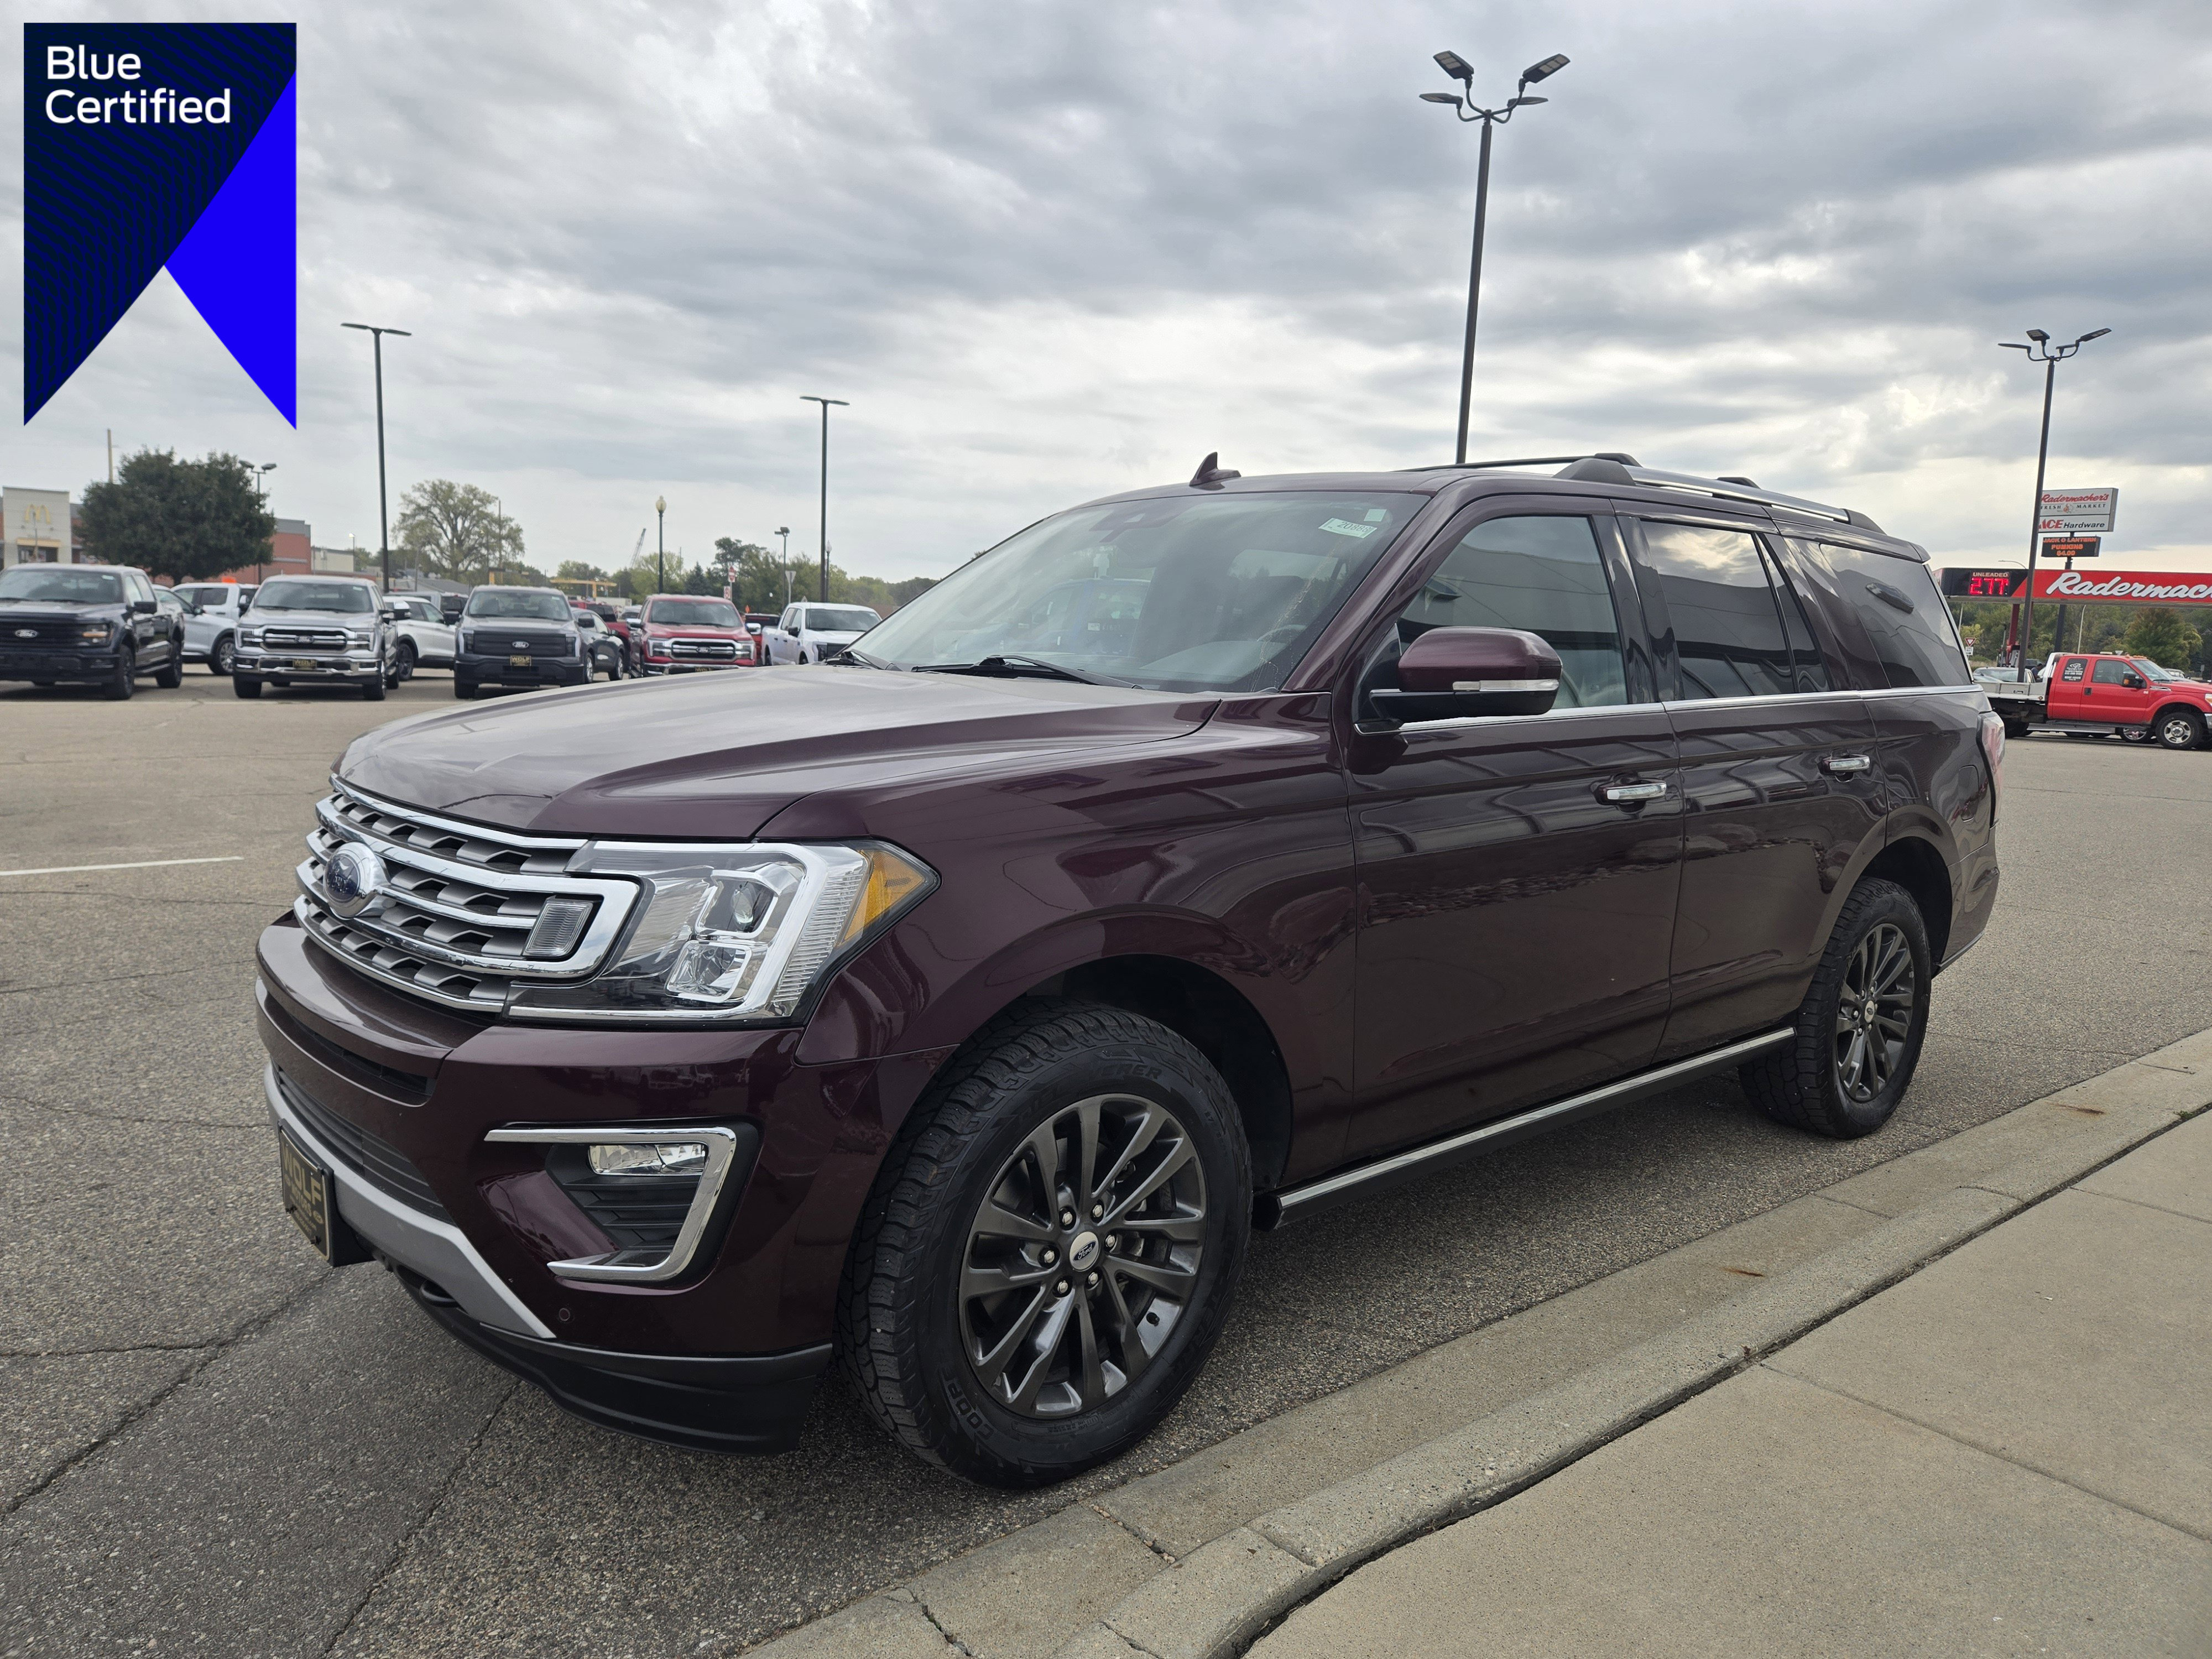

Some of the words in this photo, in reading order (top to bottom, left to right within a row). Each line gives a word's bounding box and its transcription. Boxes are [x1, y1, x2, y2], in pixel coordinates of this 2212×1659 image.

[2041, 493, 2109, 503] Radermacher's
[282, 1139, 322, 1206] WOLF
[1078, 1244, 1093, 1260] Ford
